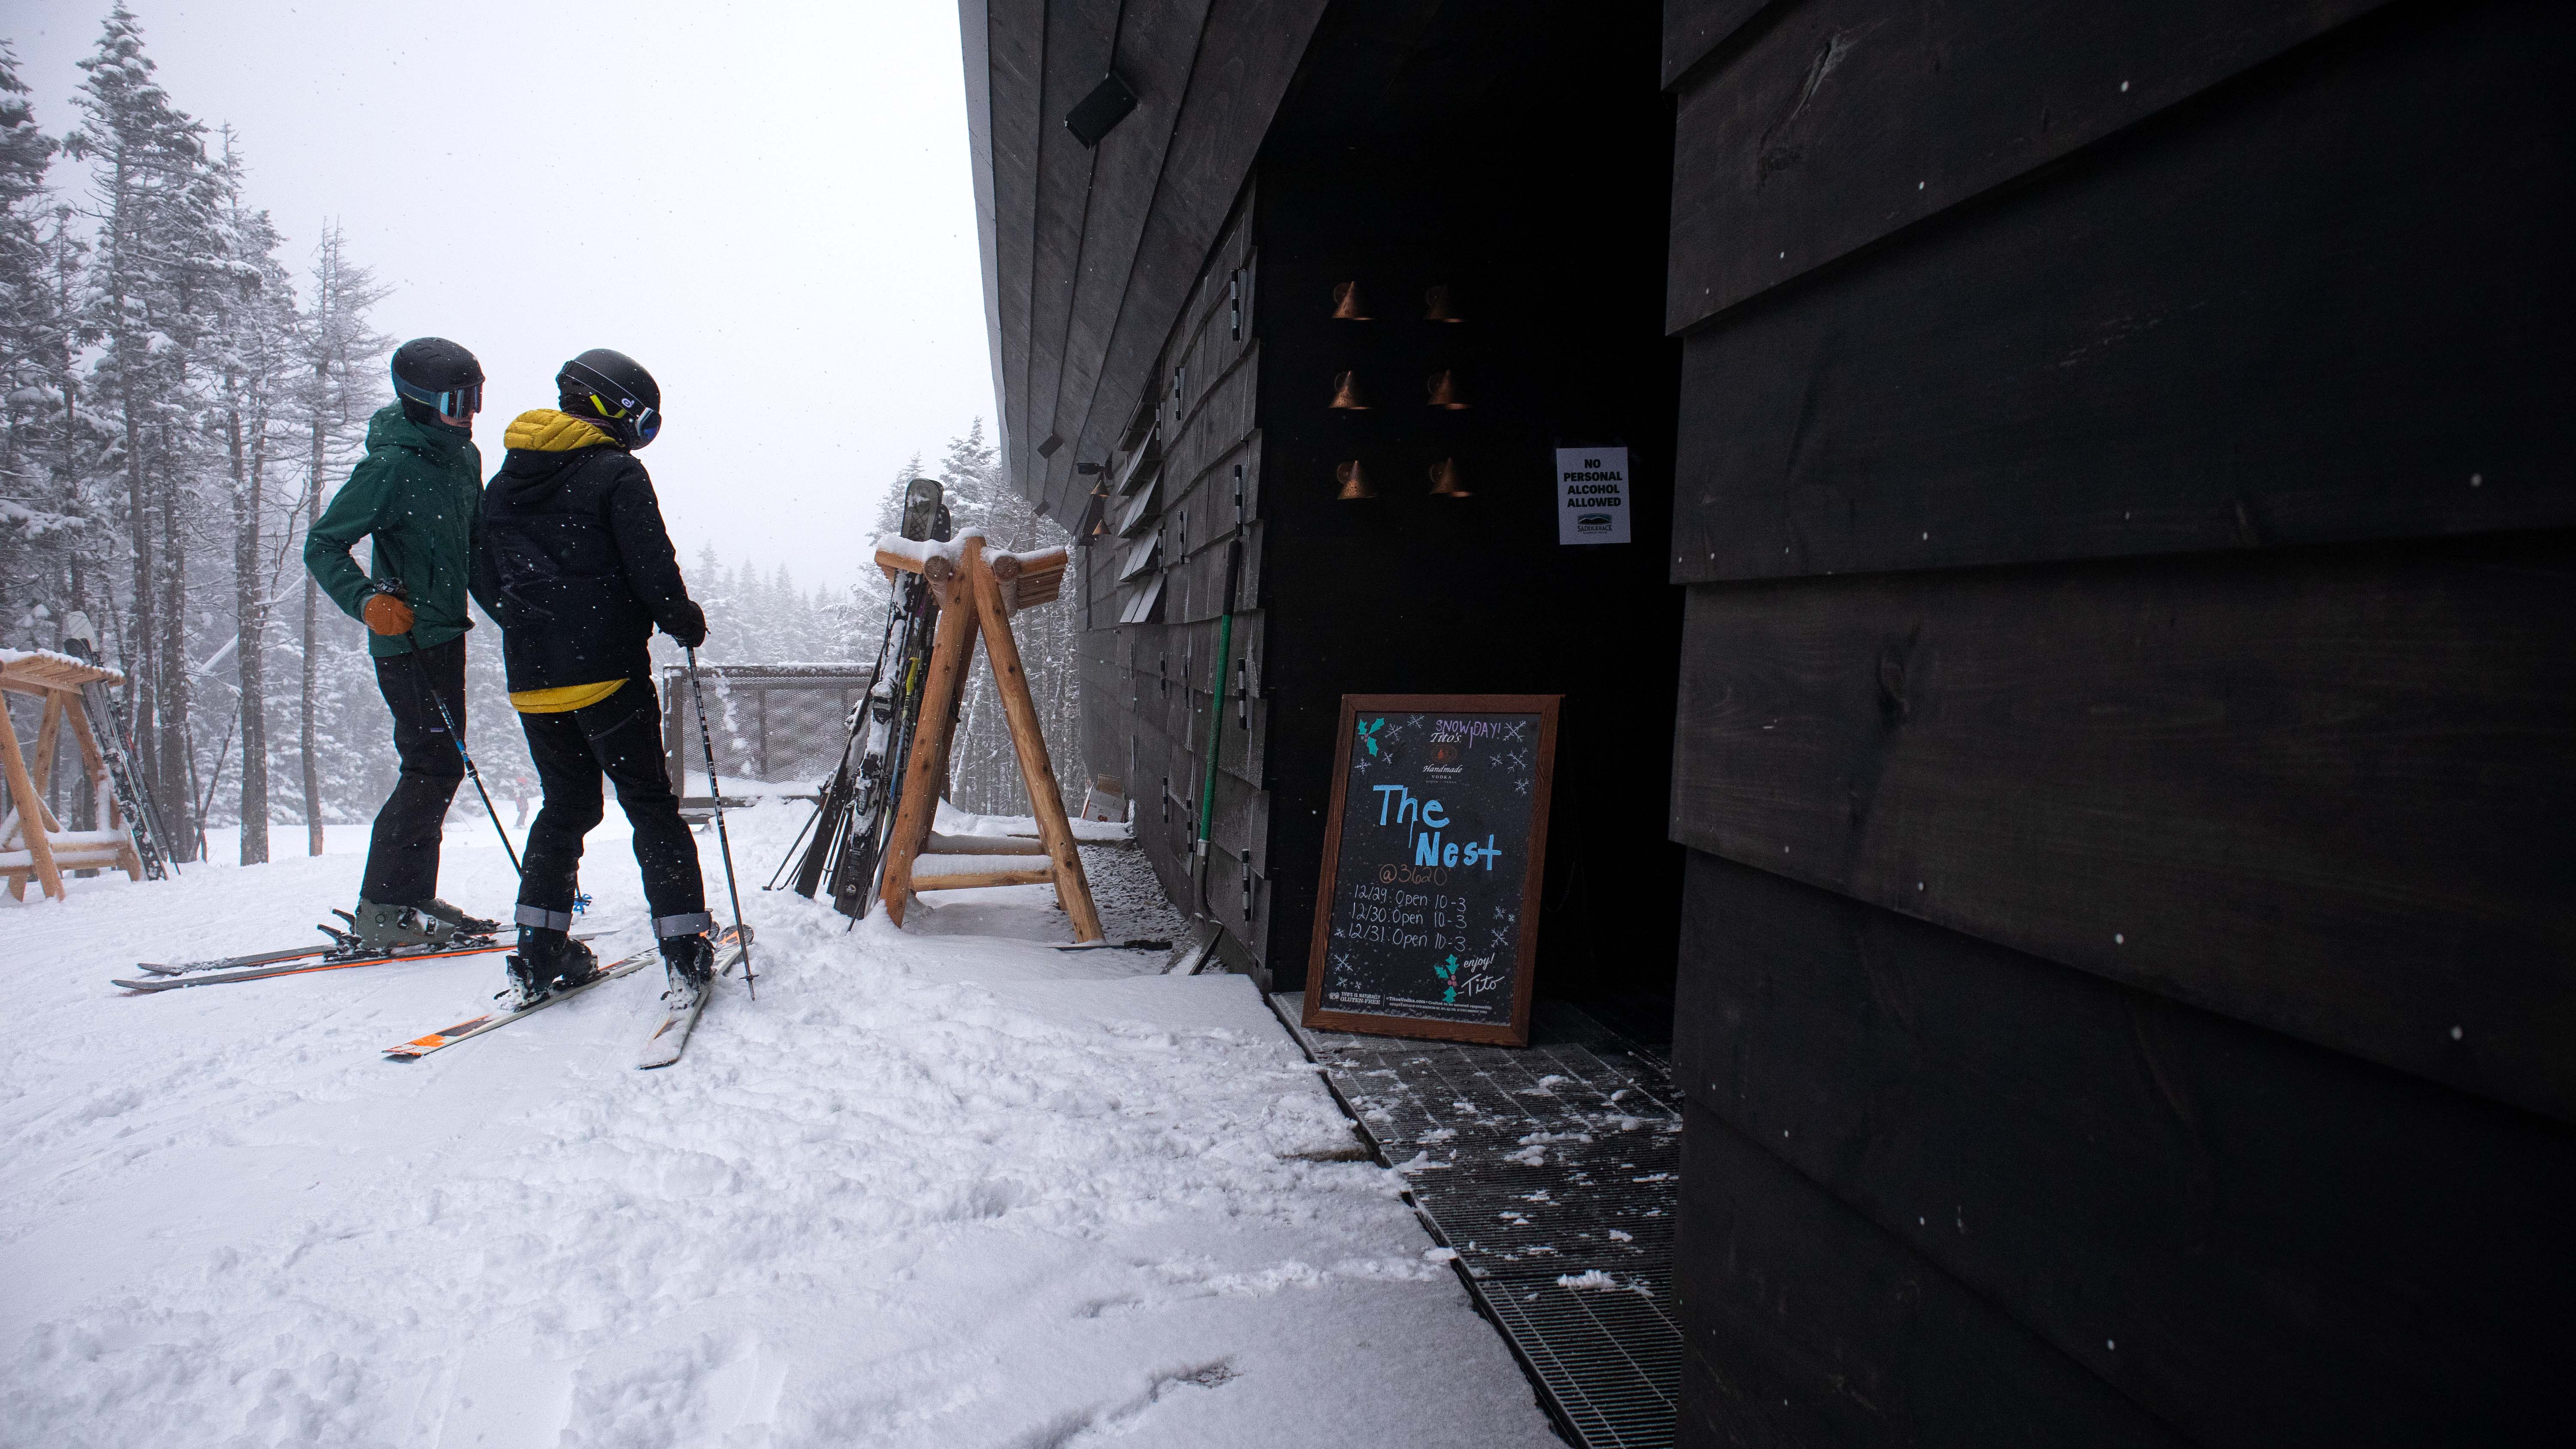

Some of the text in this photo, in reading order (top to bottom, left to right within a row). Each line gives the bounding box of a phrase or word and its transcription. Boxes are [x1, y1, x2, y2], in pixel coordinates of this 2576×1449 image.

[1584, 459, 1601, 468] NO
[1564, 472, 1622, 482] PERSONAL
[1567, 485, 1620, 494] ALCOHOL
[1567, 497, 1621, 507] ALLOWED
[1436, 720, 1501, 739] SNOW DAY!
[1422, 764, 1463, 773] Handmade
[1373, 784, 1450, 828] The
[1415, 831, 1502, 870] Nest
[1379, 864, 1447, 885] @3620
[1396, 890, 1428, 906] Open
[1392, 909, 1423, 926] Open
[1392, 928, 1428, 949] Open
[1464, 952, 1495, 973] enjoy!
[1340, 996, 1381, 1005] GLUTEN-FREE
